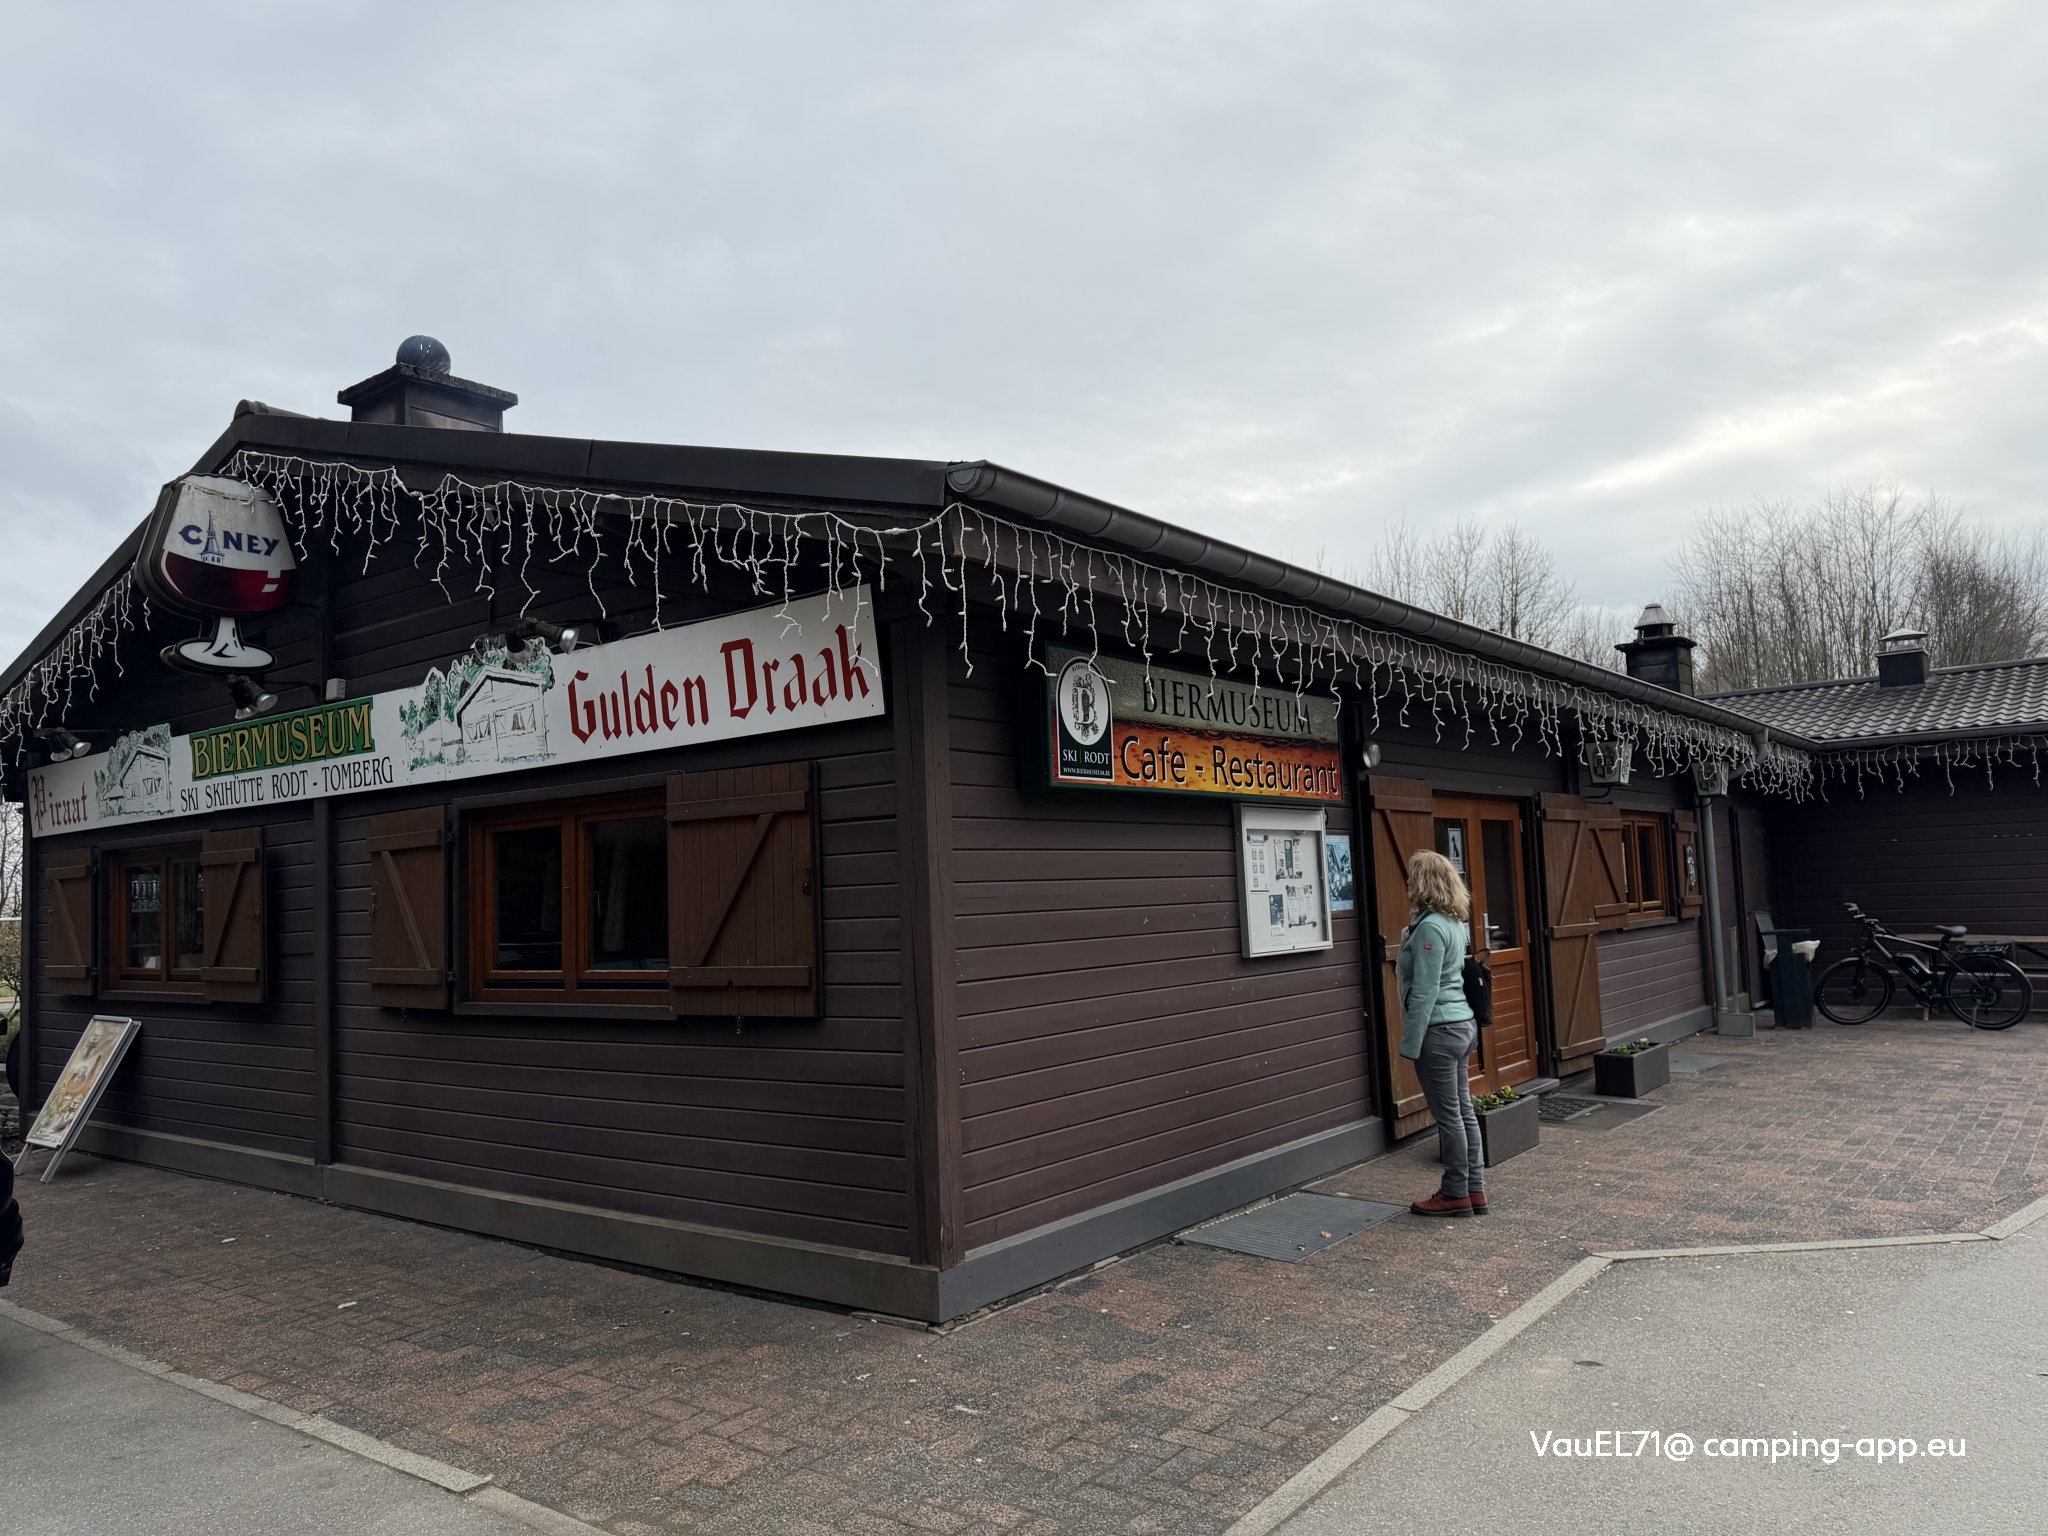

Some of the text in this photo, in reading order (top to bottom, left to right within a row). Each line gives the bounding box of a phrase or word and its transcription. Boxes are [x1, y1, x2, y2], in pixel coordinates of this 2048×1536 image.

[567, 624, 870, 745] Gulden Draak
[1140, 675, 1313, 735] BIERMUSEUM
[192, 703, 373, 779] BIERMUSEUM
[1063, 749, 1110, 765] SKI RODT
[1121, 736, 1187, 785] Cafe
[1213, 745, 1339, 795] Restaurant
[31, 774, 89, 833] Piraat
[180, 787, 199, 812] SKI
[205, 776, 264, 809] SKIHÜTTE
[272, 770, 309, 799] RODT
[321, 756, 394, 792] TOMBERG
